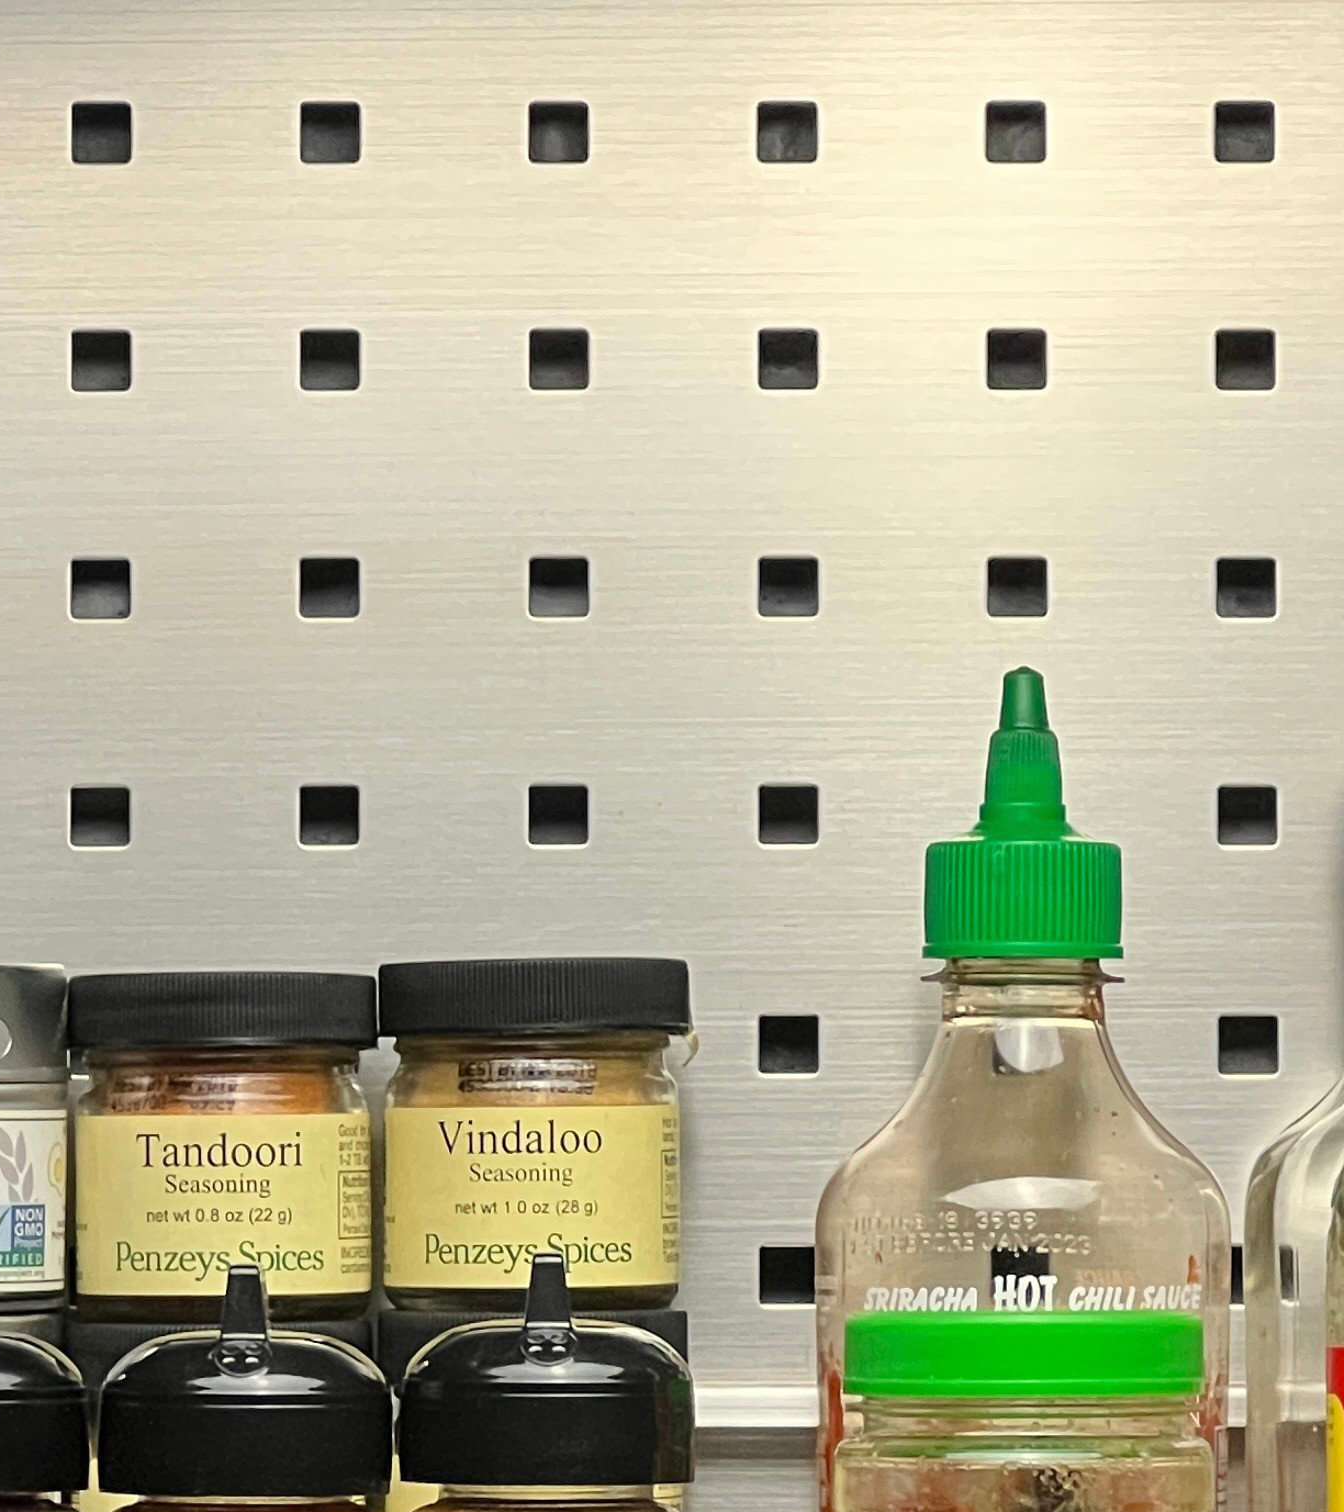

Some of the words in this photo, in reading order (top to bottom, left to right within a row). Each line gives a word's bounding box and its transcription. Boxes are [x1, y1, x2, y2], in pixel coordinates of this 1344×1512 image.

[437, 1119, 603, 1155] Vindaloo
[136, 1132, 303, 1168] Tandoori
[165, 1173, 270, 1198] Seasoning
[469, 1162, 573, 1187] Seasoning
[14, 1208, 44, 1221] NON
[146, 1208, 168, 1223] net
[173, 1208, 190, 1223] wt
[195, 1208, 219, 1223] 0.8
[225, 1210, 243, 1223] oz
[248, 1207, 272, 1225] (22
[277, 1207, 293, 1225] g)
[455, 1201, 476, 1214] net
[481, 1201, 497, 1214] wt
[504, 1200, 527, 1214] 1.0
[532, 1202, 549, 1214] oz
[556, 1199, 580, 1216] (28
[584, 1200, 598, 1216] g)
[14, 1222, 44, 1236] GMO
[116, 1242, 230, 1282] Penzeys
[425, 1233, 537, 1274] Penzeys
[863, 1286, 978, 1312] SRIRACHA
[993, 1274, 1058, 1312] HOT
[1068, 1285, 1136, 1312] CHILI
[1141, 1283, 1202, 1310] SAUCE
